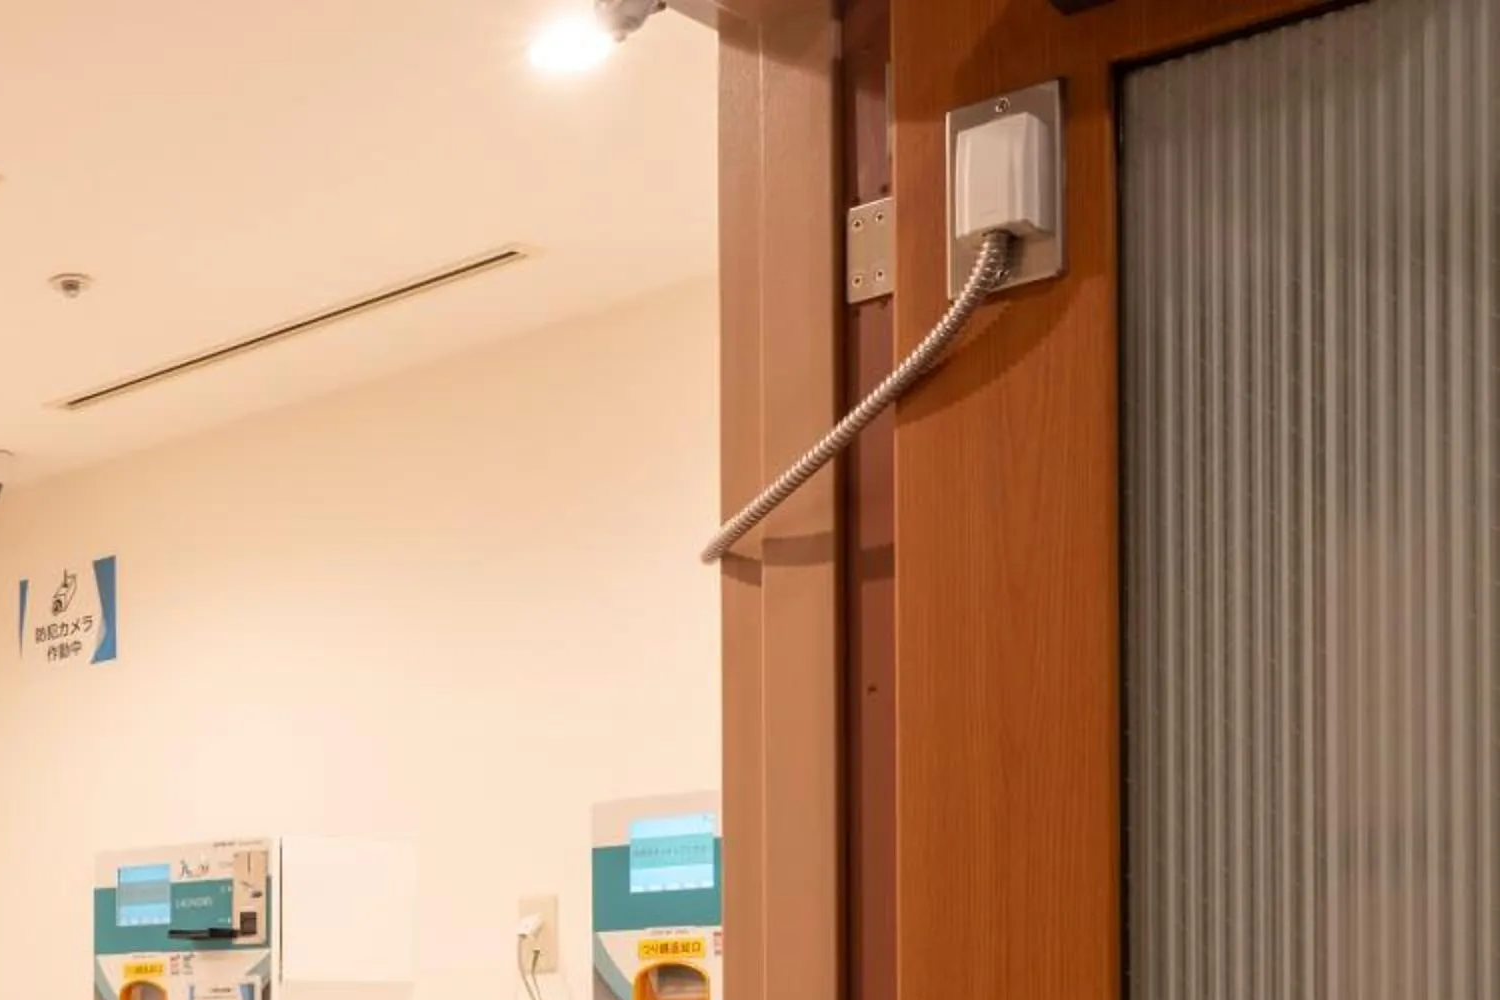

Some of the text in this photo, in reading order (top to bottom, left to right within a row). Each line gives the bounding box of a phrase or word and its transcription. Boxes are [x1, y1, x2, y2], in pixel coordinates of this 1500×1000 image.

[35, 614, 94, 644] 防犯カメラ
[46, 640, 83, 663] 作動中
